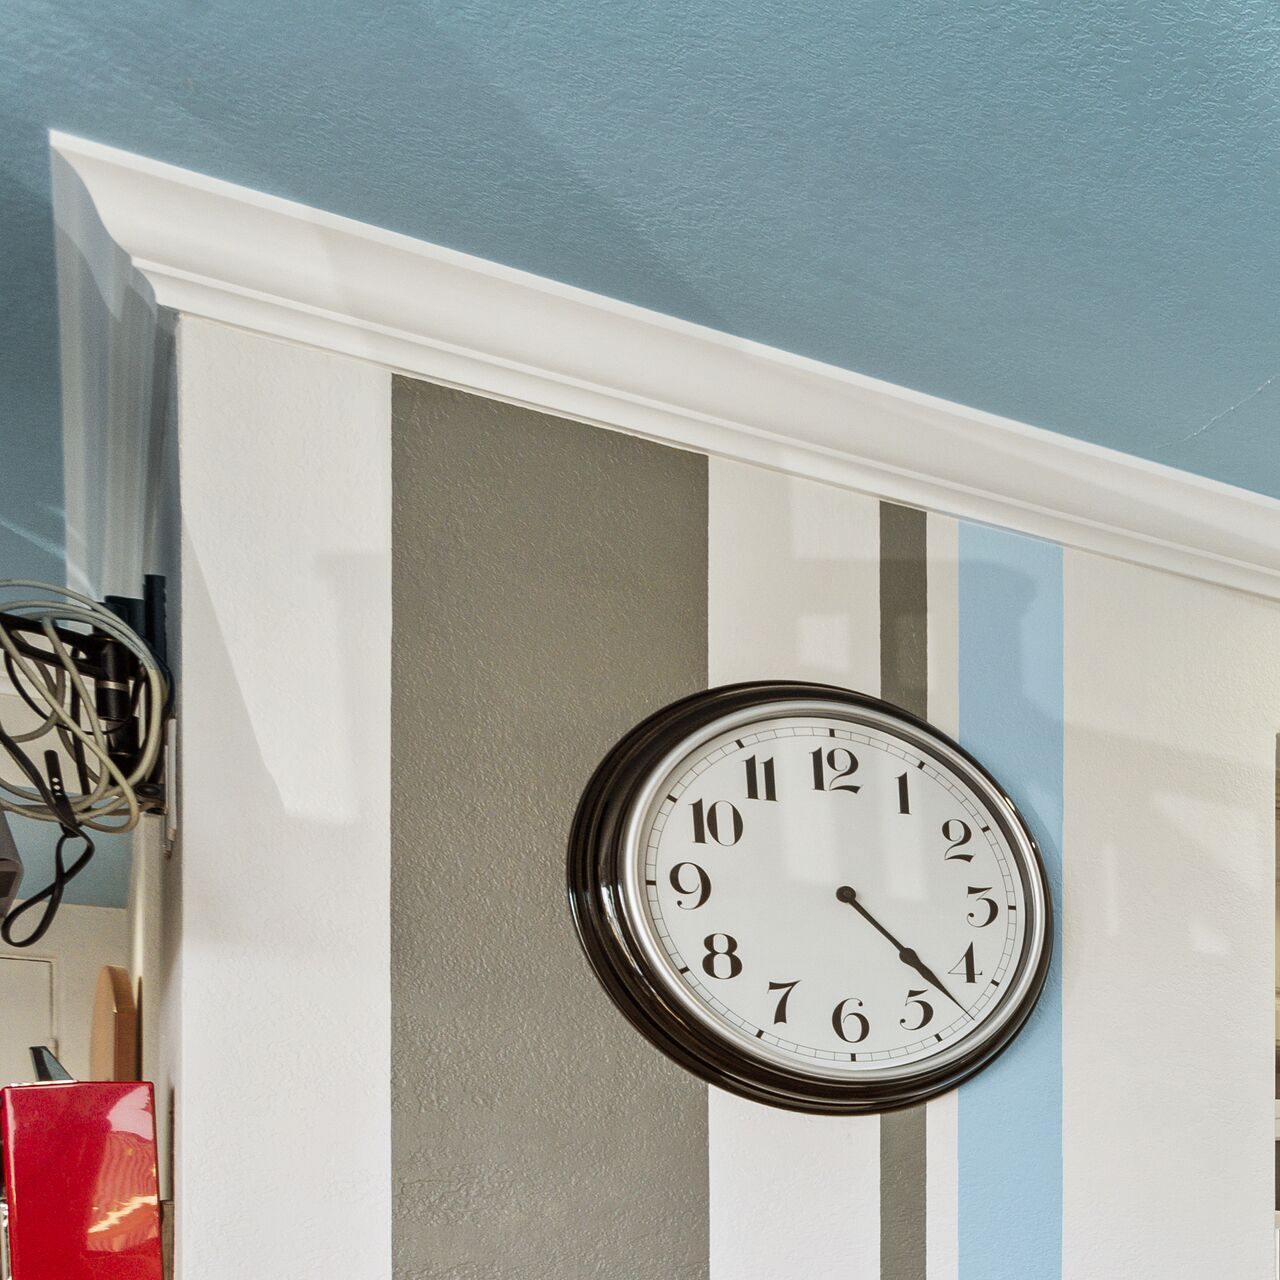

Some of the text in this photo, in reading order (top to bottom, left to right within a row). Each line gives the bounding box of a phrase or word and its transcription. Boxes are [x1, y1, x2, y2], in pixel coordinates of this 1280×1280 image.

[743, 755, 778, 802] 11
[809, 747, 863, 795] 12
[895, 772, 912, 815] 1
[689, 798, 744, 847] 10
[942, 819, 974, 863] 2
[669, 862, 712, 910] 9
[966, 886, 998, 928] 3
[702, 933, 743, 980] 8
[948, 941, 983, 984] 4
[768, 980, 801, 1025] 7
[832, 997, 870, 1044] 6
[900, 989, 934, 1031] 5
